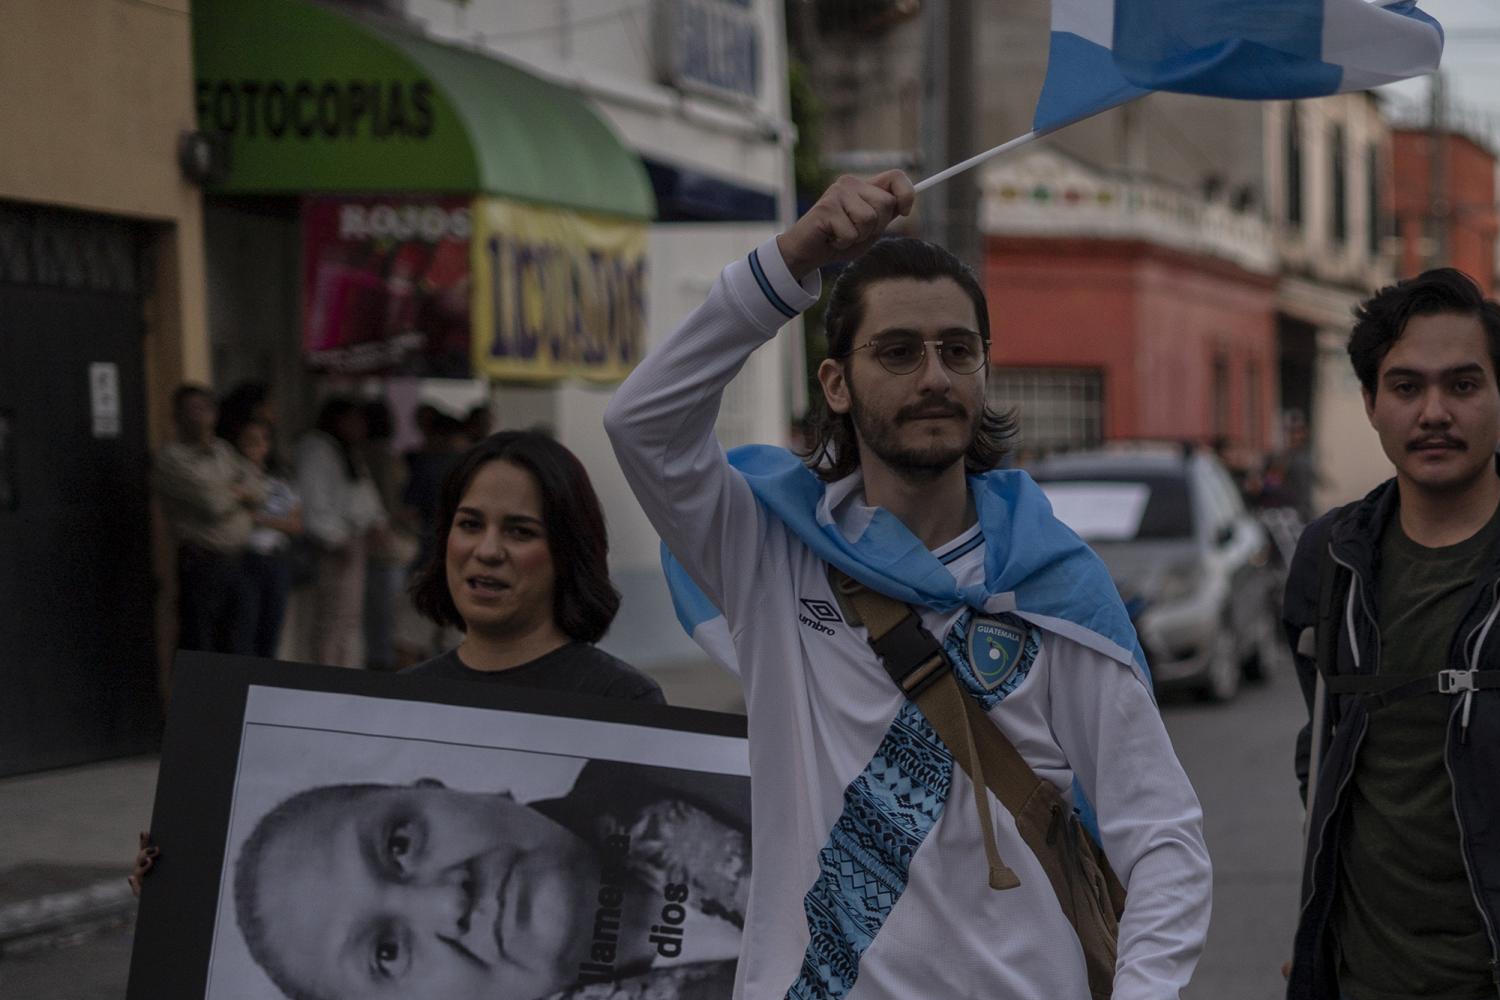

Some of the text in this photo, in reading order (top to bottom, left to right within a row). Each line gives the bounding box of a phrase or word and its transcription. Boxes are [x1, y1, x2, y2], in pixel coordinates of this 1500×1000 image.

[798, 613, 836, 636] umbro
[977, 625, 1020, 642] GUATEMALA
[649, 882, 689, 958] dios
